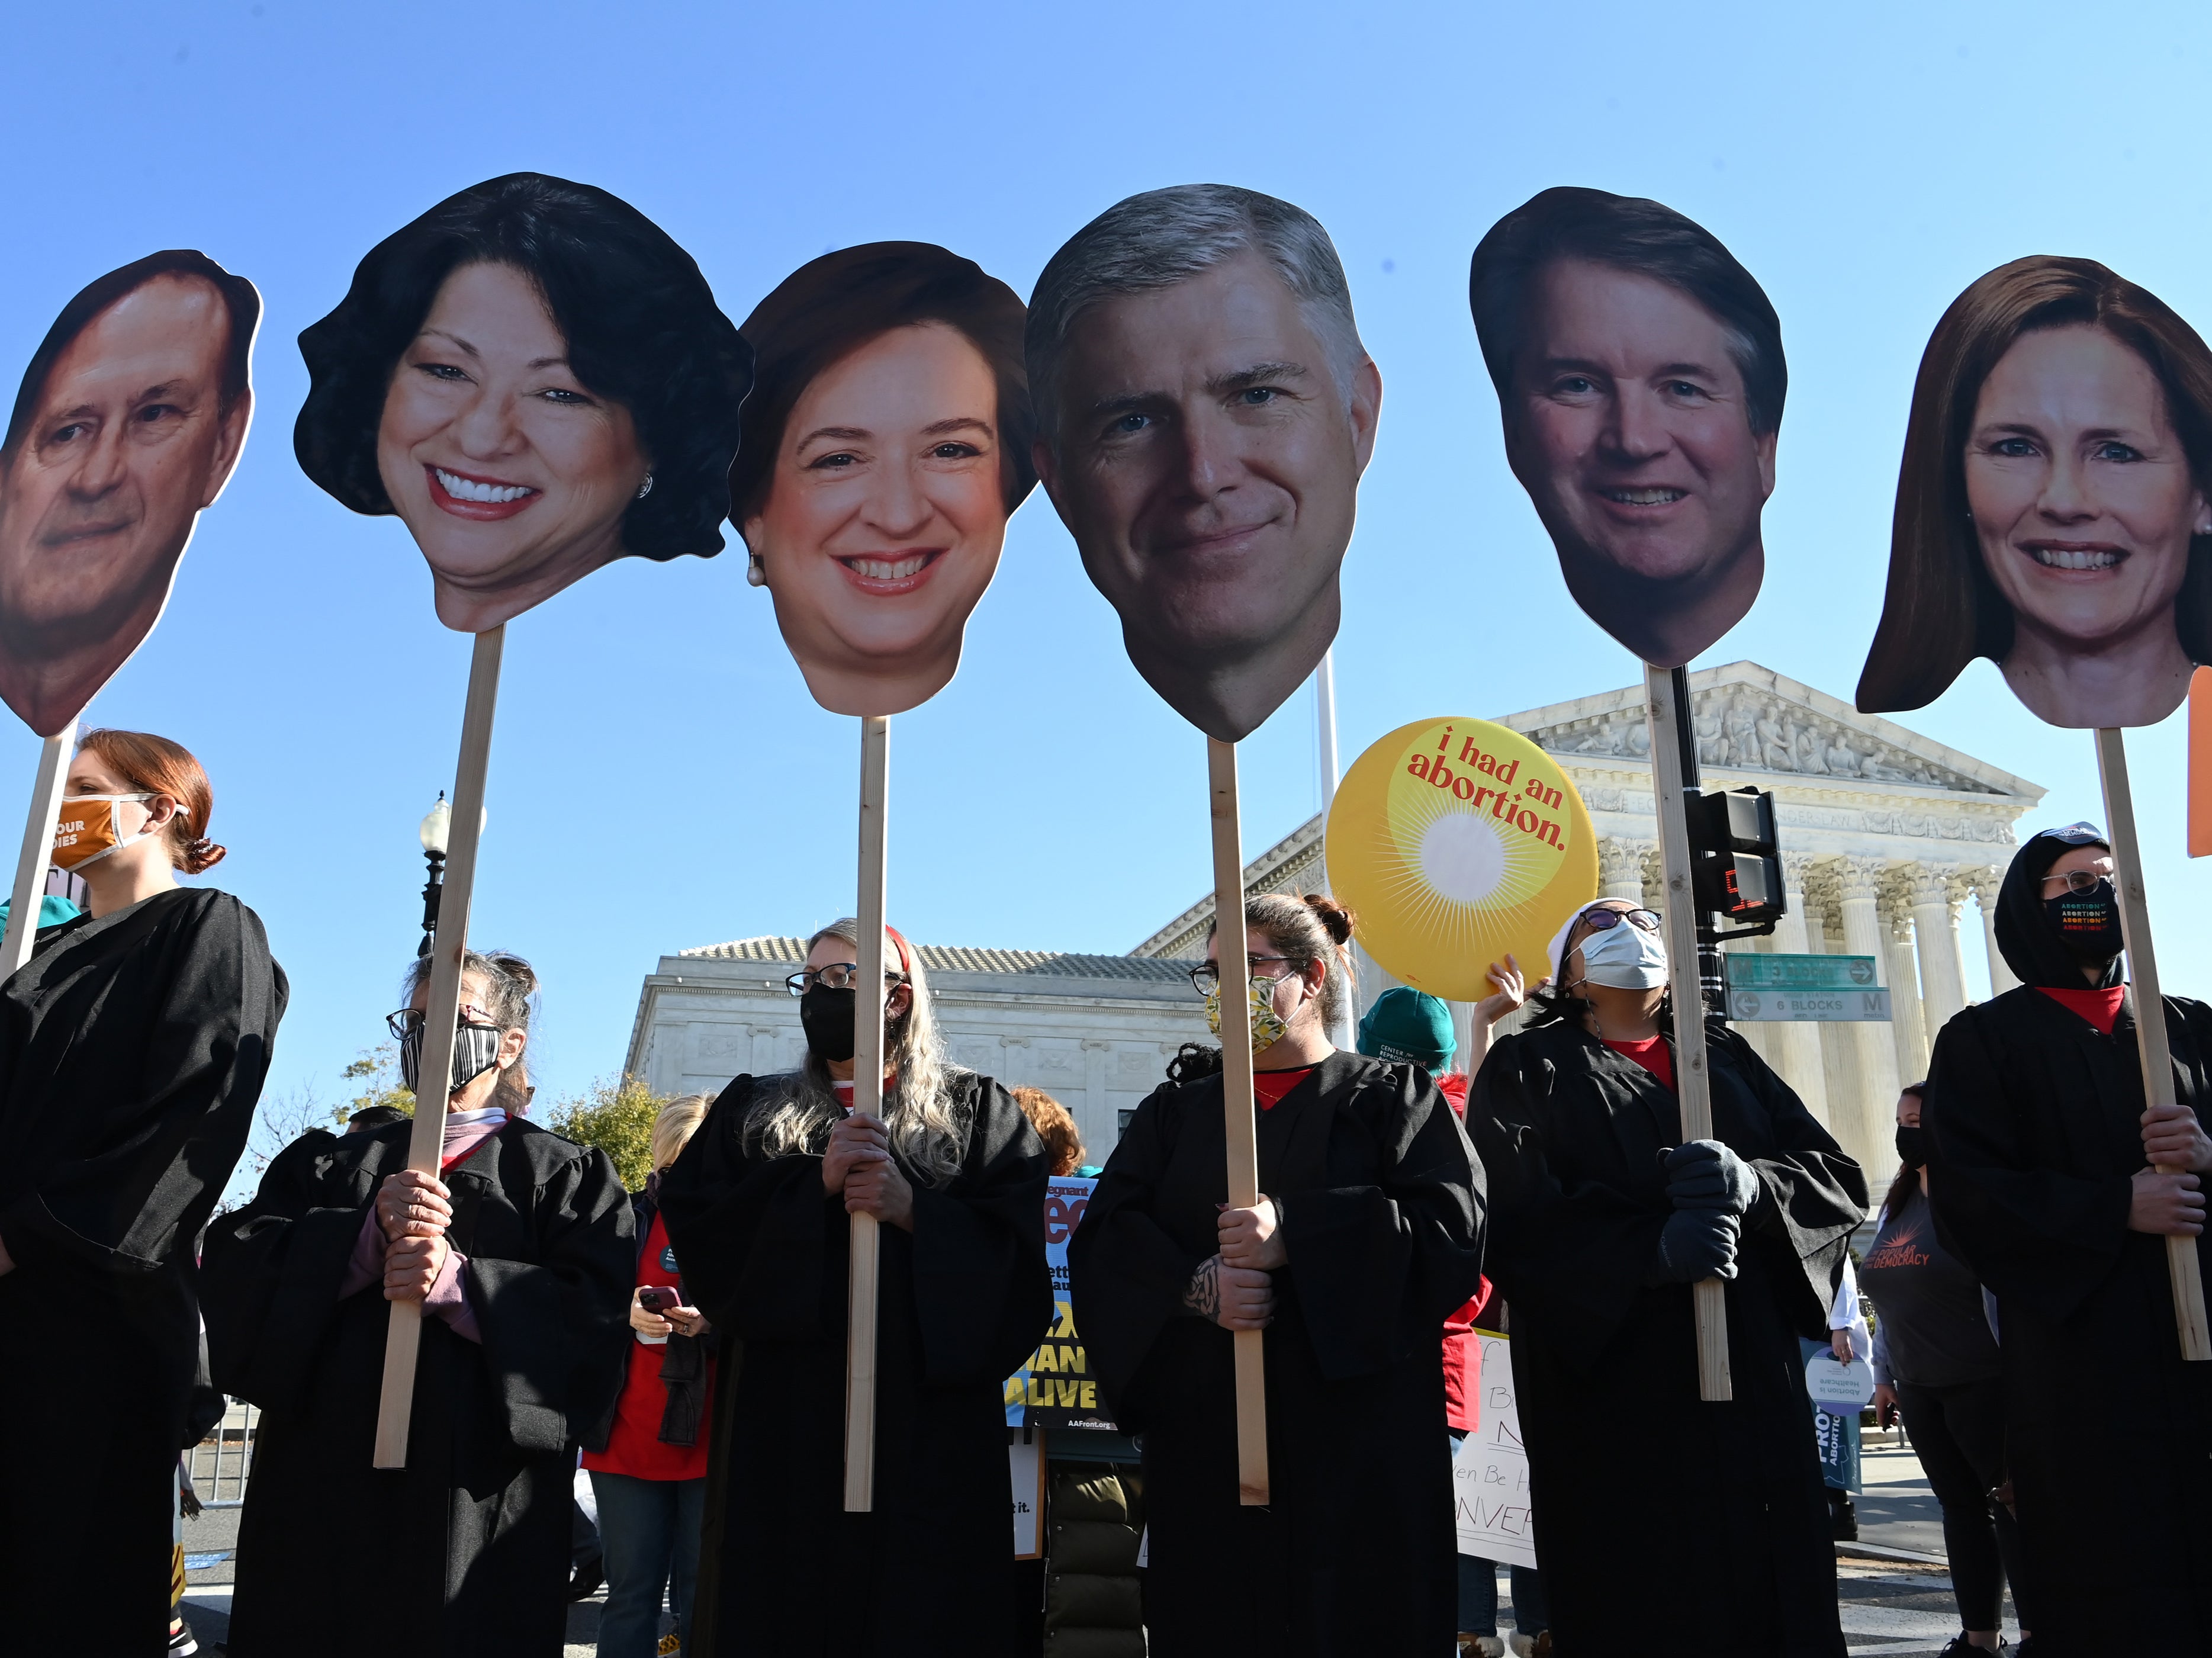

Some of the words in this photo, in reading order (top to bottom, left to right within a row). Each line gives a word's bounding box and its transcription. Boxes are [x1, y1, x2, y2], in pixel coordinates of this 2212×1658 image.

[1438, 725, 1454, 751] i
[1458, 736, 1520, 786] had
[1525, 779, 1563, 810] an
[1407, 754, 1565, 852] abortion.
[56, 820, 85, 835] OUR
[1777, 1001, 1785, 1010] 6
[1792, 1000, 1843, 1010] BLOCKS
[1864, 993, 1883, 1011] M
[1380, 1050, 1427, 1066] REPRODUCTIVE
[1381, 1045, 1404, 1056] CENTER
[1877, 1245, 1917, 1259] POPULAR
[1873, 1254, 1930, 1268] DEMOCRACY
[1046, 1302, 1079, 1338] X
[1479, 1341, 1502, 1376] f
[1819, 1379, 1860, 1387] Healthcare
[1004, 1377, 1097, 1408] ALIVE
[1827, 1388, 1860, 1396] Abortion
[1068, 1420, 1111, 1429] AAFront.org
[1815, 1405, 1830, 1463] PRO
[1484, 1465, 1507, 1486] Be
[1018, 1502, 1030, 1513] it.
[1455, 1496, 1532, 1535] NVE
